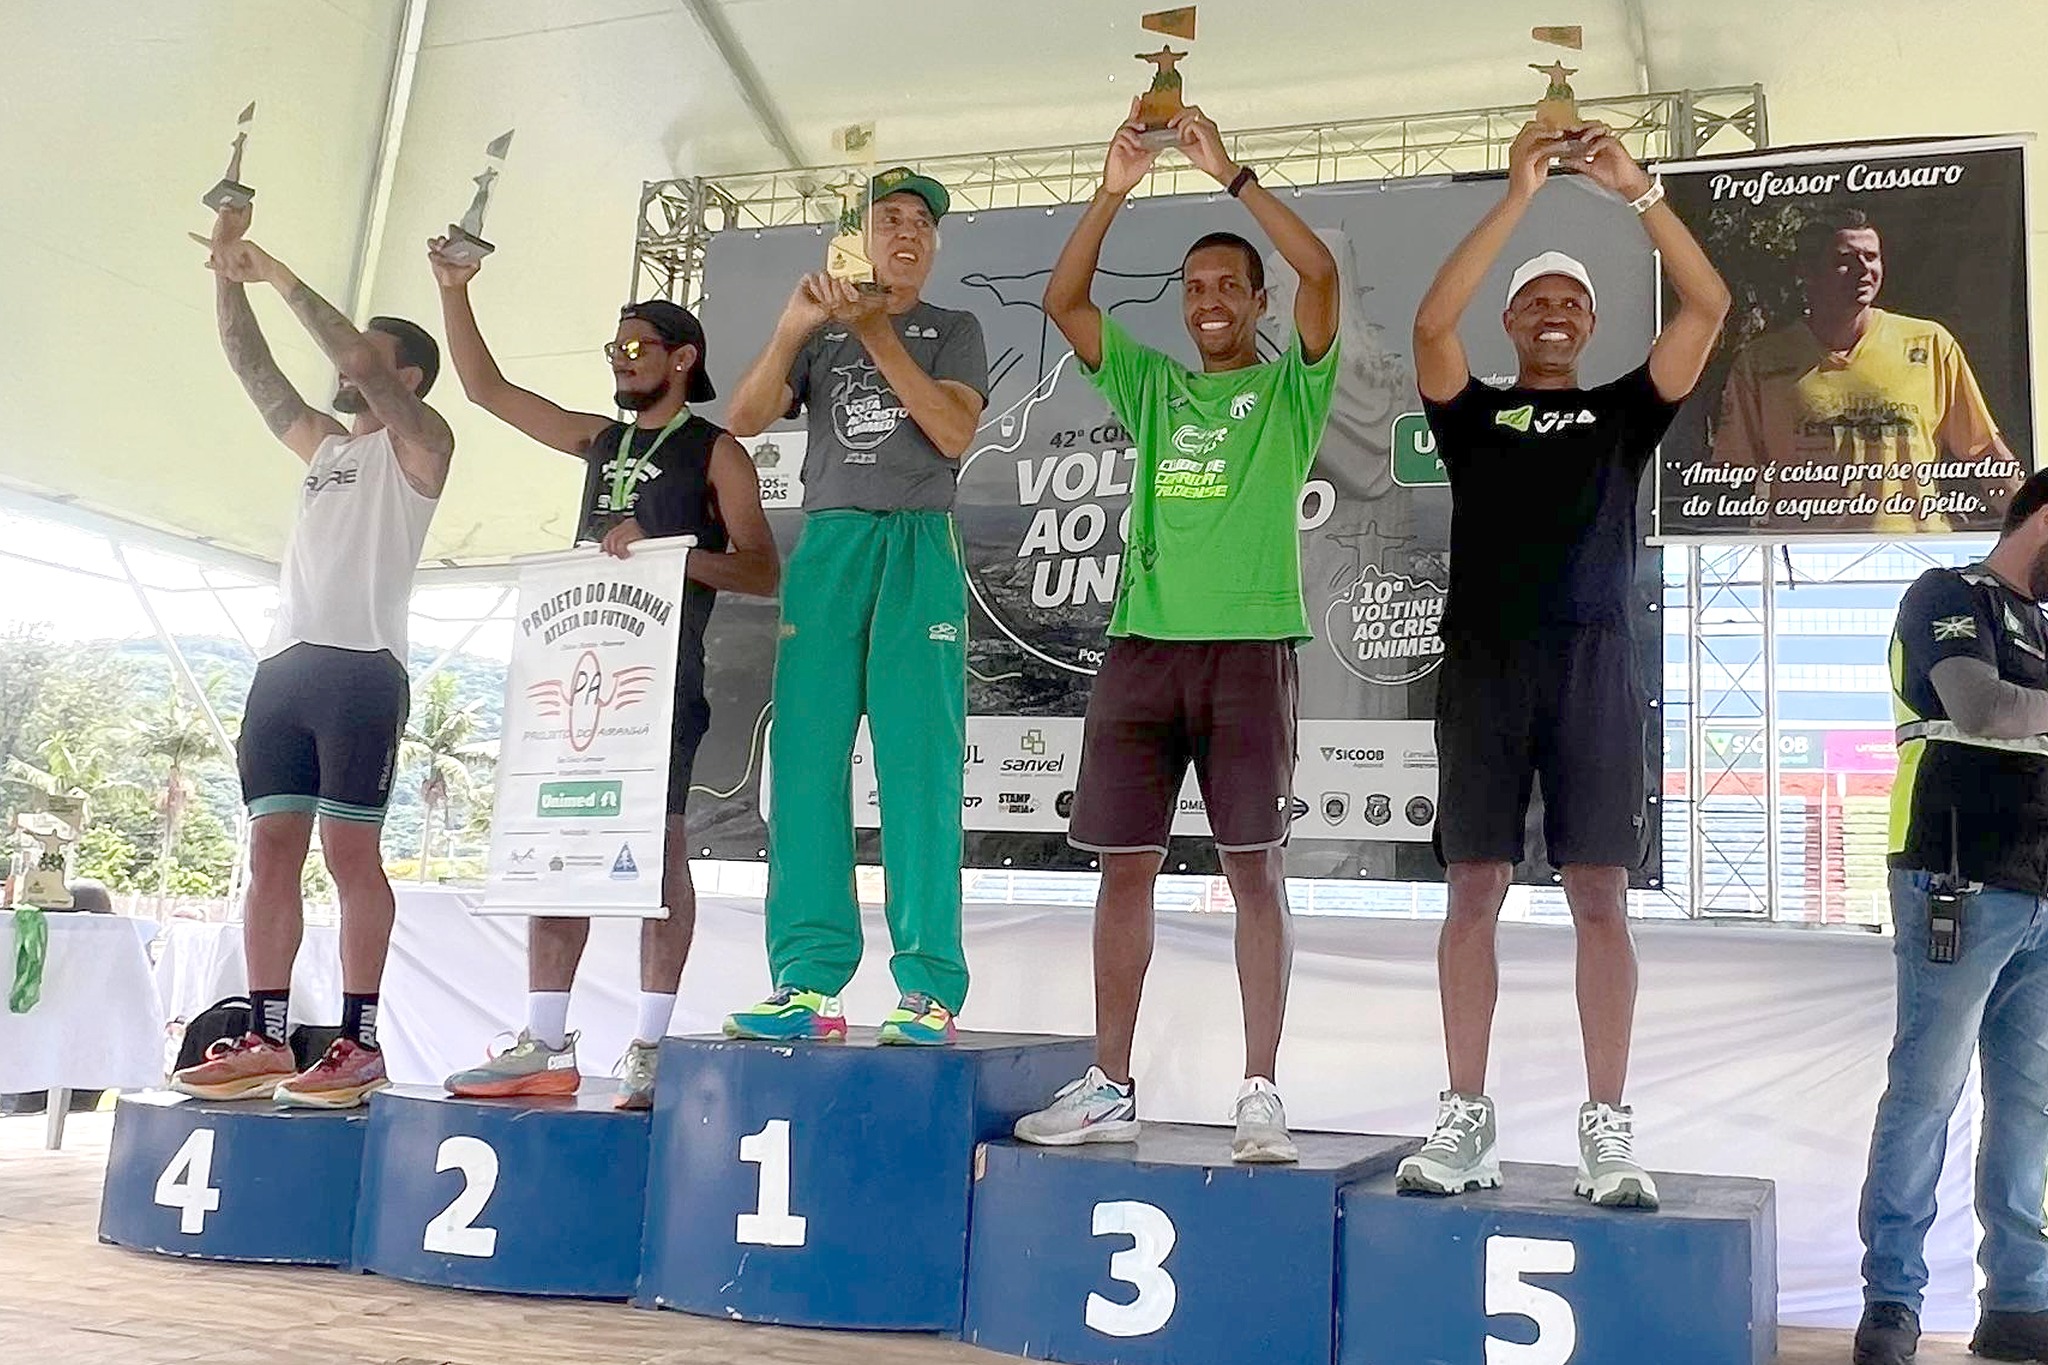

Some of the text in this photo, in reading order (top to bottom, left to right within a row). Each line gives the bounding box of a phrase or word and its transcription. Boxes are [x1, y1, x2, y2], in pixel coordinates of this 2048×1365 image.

[1709, 163, 1966, 206] Professor Cassaro
[1764, 460, 1778, 483] é
[1780, 461, 1838, 483] coisa
[1841, 463, 1883, 488] pra
[1887, 462, 1913, 481] se
[1916, 456, 2027, 487] guardar,
[1682, 495, 1713, 517] do
[1717, 494, 1770, 517] lado
[1775, 494, 1880, 521] esquerdo
[1885, 491, 1917, 515] do
[1018, 503, 1107, 558] AO
[521, 582, 675, 638] PROJETO DO AMANHÃ
[543, 609, 646, 645] ATLETA DO FUTURO
[1352, 616, 1442, 641] AO CRIS
[1358, 635, 1446, 661] UNIMED
[1000, 753, 1065, 772] sanvel
[1335, 749, 1385, 761] SICOOB
[1732, 735, 1810, 754] SICOB
[541, 793, 597, 809] Unimed
[263, 999, 288, 1045] RUN
[359, 1004, 378, 1048] RUN
[154, 1128, 221, 1235] 4
[423, 1136, 500, 1258] 2
[734, 1118, 807, 1246] 1
[1085, 1200, 1178, 1338] 3
[1483, 1234, 1577, 1365] 5
